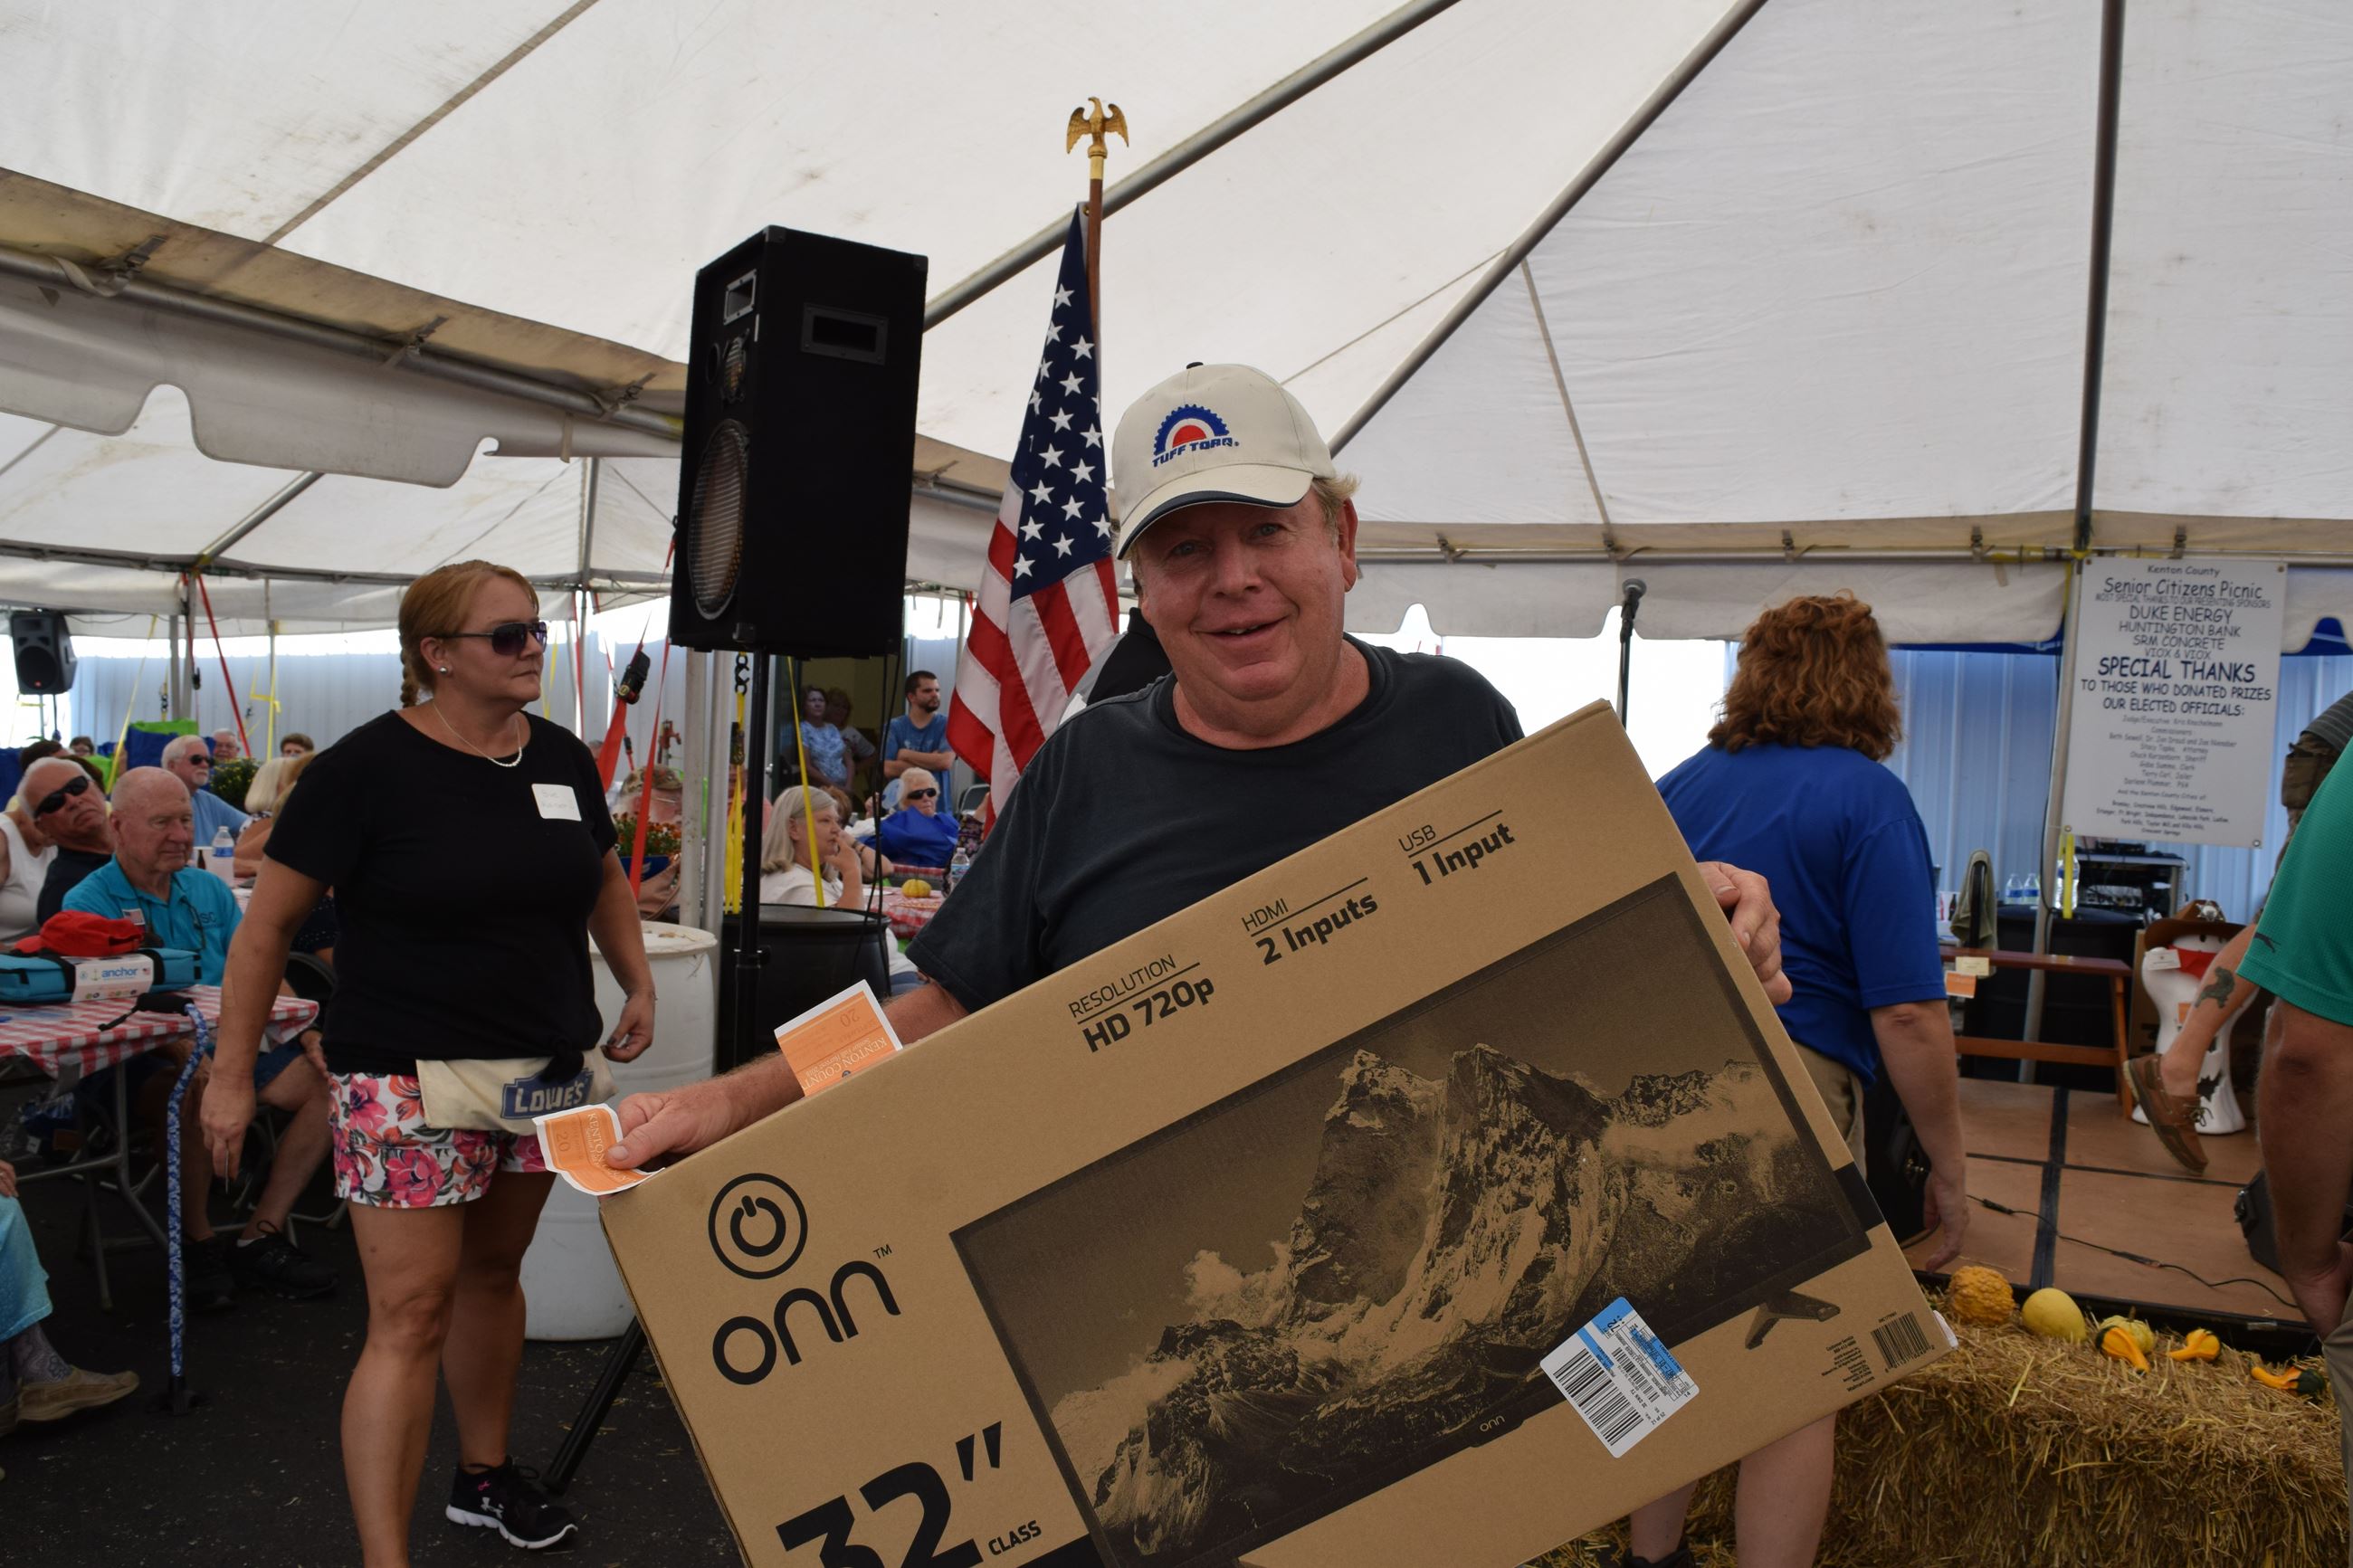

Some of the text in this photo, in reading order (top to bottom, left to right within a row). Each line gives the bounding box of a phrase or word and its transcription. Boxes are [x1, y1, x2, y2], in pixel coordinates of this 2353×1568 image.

[1152, 437, 1233, 467] TUFF TORQ
[2147, 565, 2220, 577] Kenton County
[2104, 577, 2262, 599] Senior Citizens Picnic
[2129, 605, 2233, 623] DUKE ENERGY
[2119, 621, 2241, 637] HUNTINGTON BANK
[2133, 635, 2224, 650] SRM CONCRETE
[2145, 647, 2172, 658] VIOX
[2185, 650, 2212, 660] VIOX
[2098, 657, 2255, 683] SPECIAL THANKS
[2082, 679, 2272, 701] TO THOSE WHO DONATED PRIZES
[2103, 698, 2244, 717] OUR ELECTED OFFICIALS:
[1398, 824, 1436, 852] USB
[1412, 822, 1516, 886] 1 Input
[1241, 898, 1289, 932] HDMI
[1255, 894, 1378, 965] 2 Inputs
[101, 966, 138, 978] anchor
[1068, 954, 1176, 1019] RESOLUTION
[840, 1008, 859, 1028] 20
[1082, 977, 1215, 1054] HD 720p
[843, 1037, 888, 1066] KENTON
[514, 1080, 584, 1113] LOWE'S
[557, 1132, 569, 1153] 20
[588, 1113, 605, 1164] KENTON
[712, 1260, 901, 1385] onn
[1605, 1317, 1621, 1333] 72
[1480, 1415, 1505, 1431] onn
[987, 1519, 1043, 1556] CLASS
